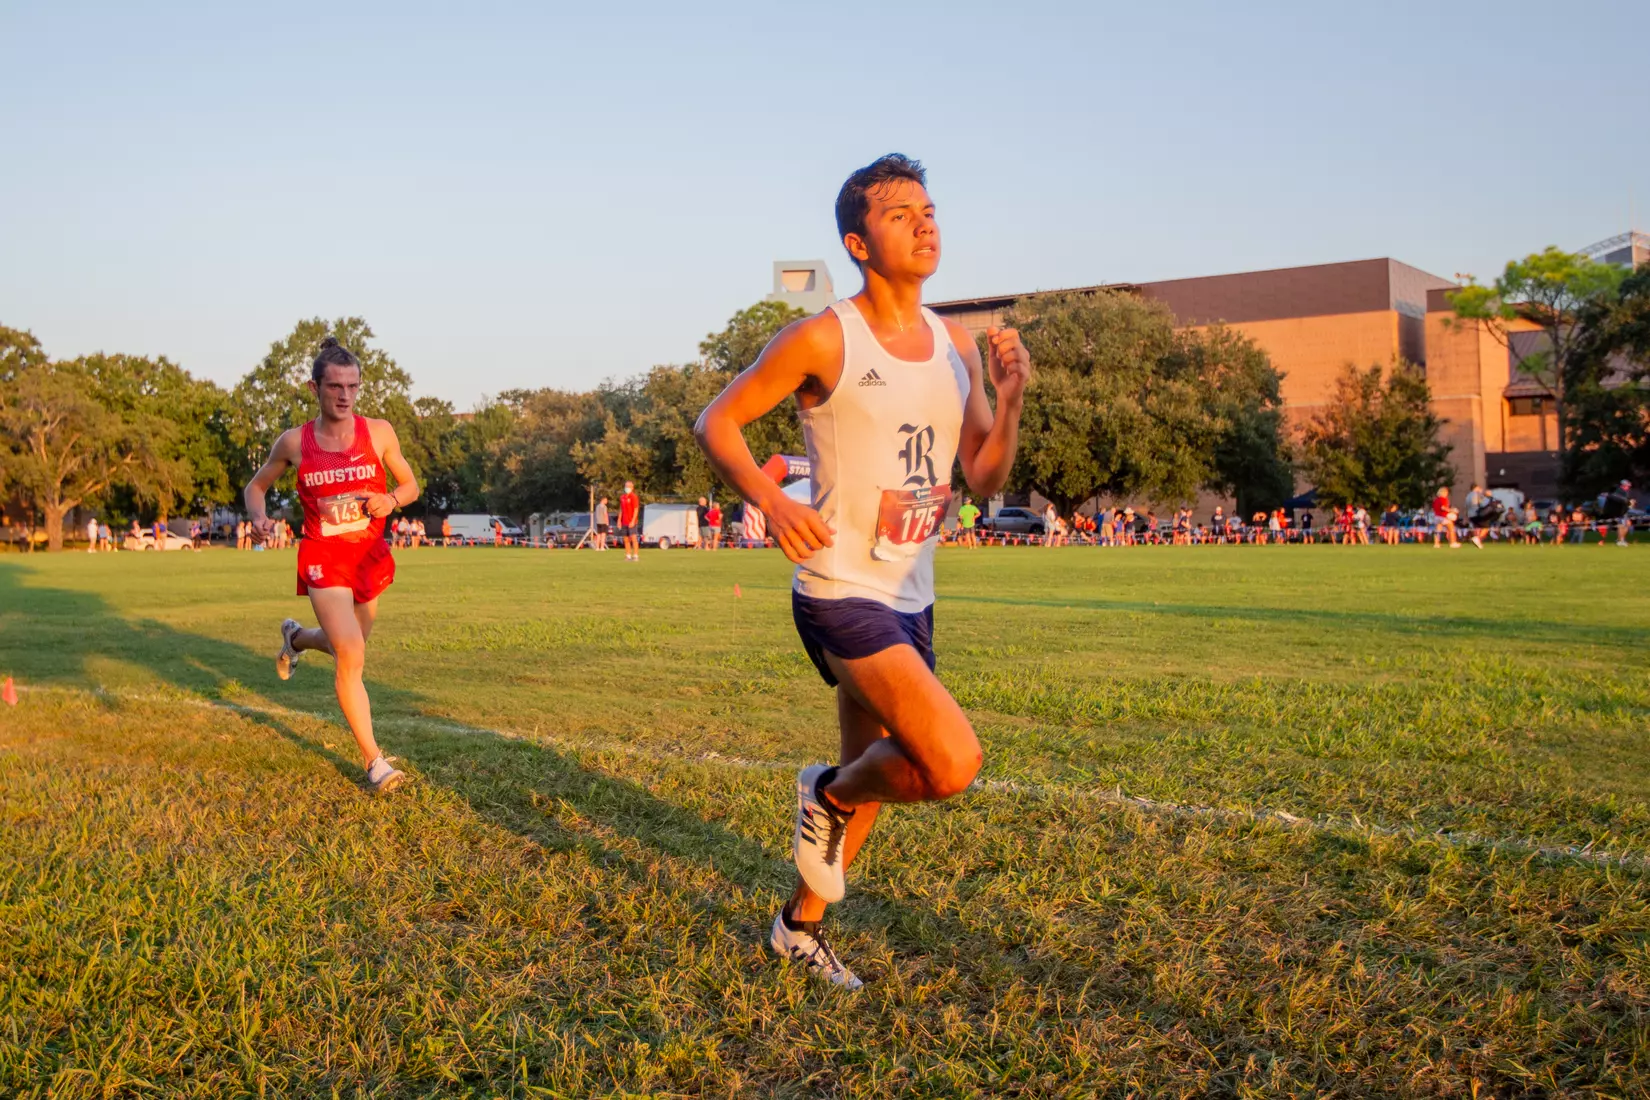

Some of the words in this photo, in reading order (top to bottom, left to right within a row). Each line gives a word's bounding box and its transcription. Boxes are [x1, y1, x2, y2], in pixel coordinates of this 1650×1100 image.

[897, 423, 939, 487] R
[304, 464, 377, 487] HOUSTON
[331, 502, 361, 524] 143
[901, 505, 939, 541] 175
